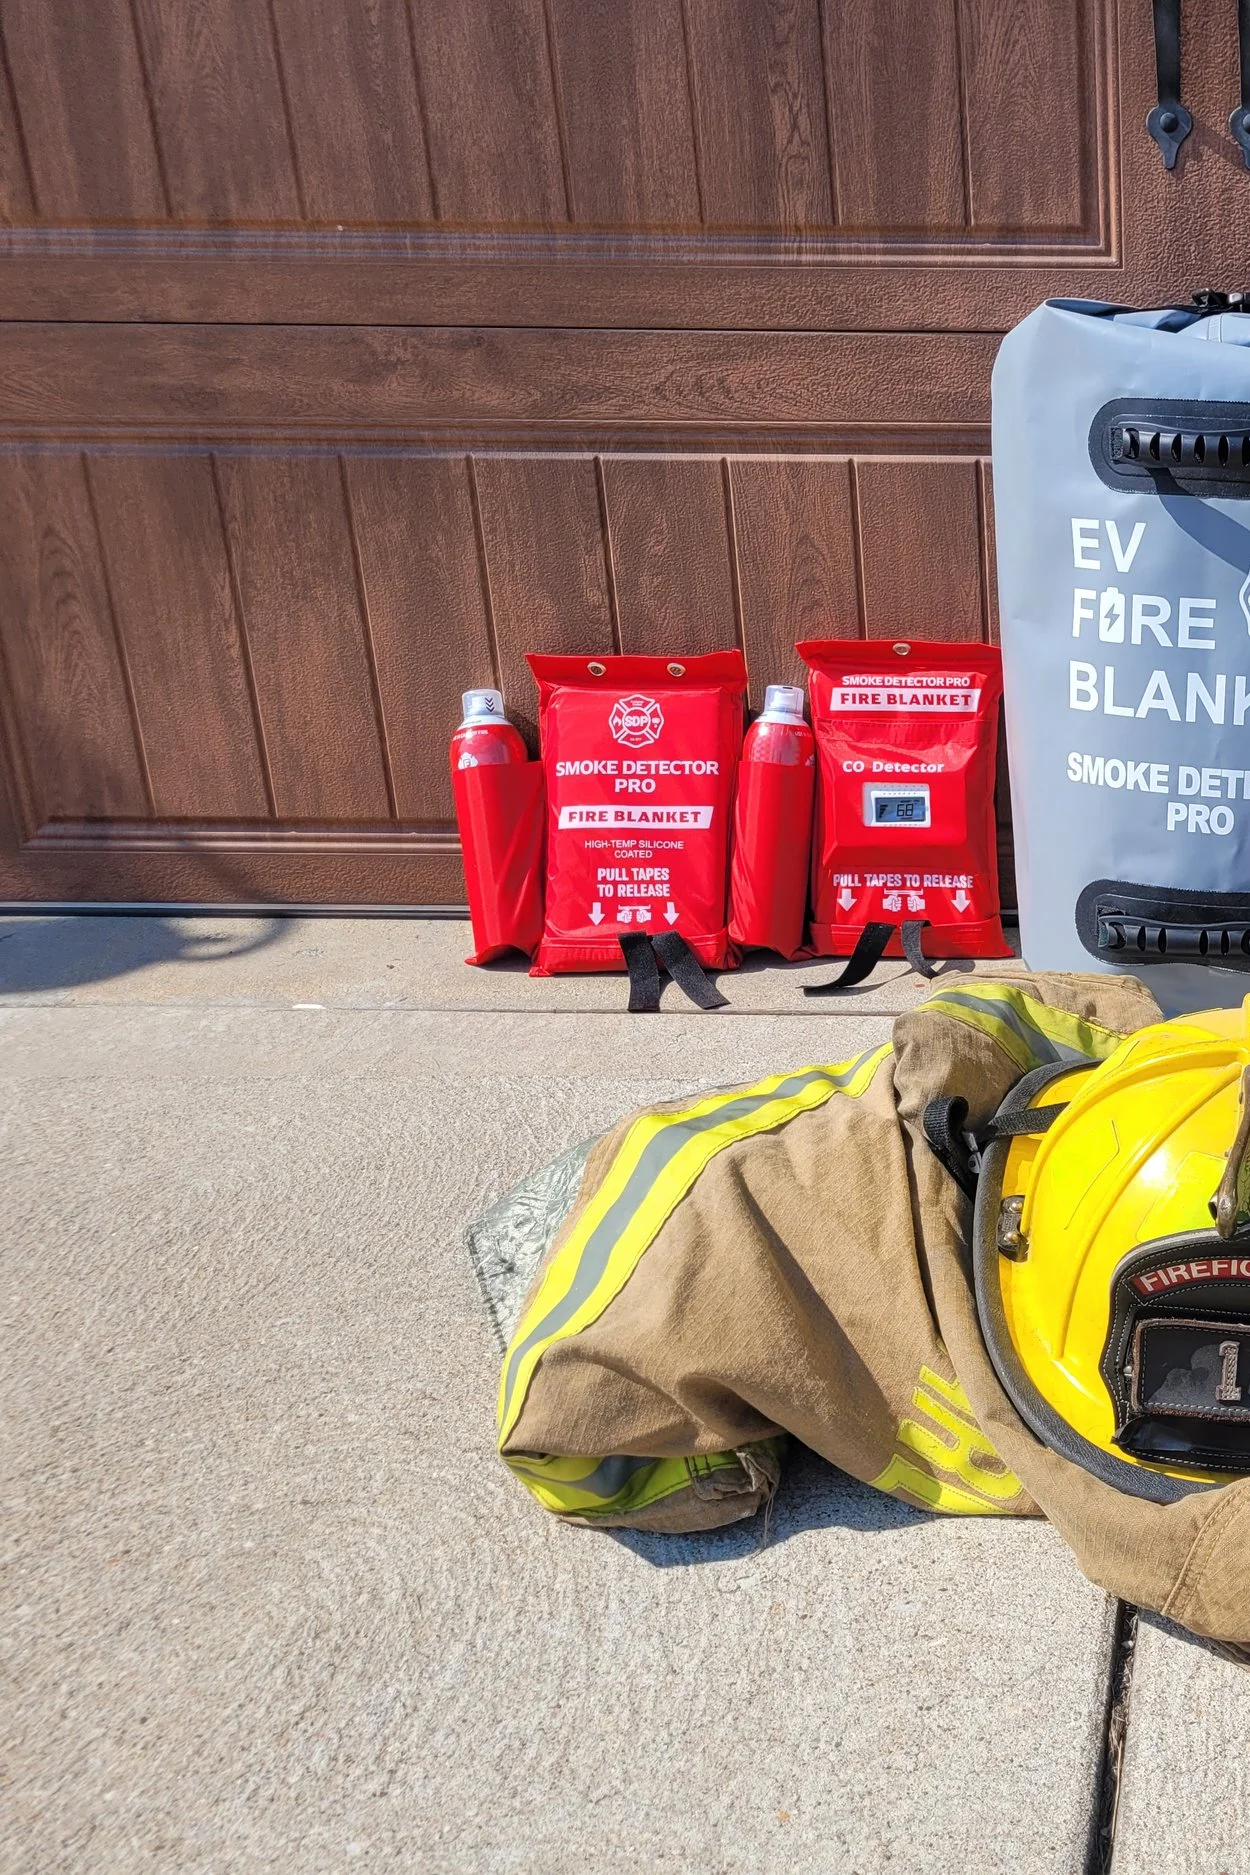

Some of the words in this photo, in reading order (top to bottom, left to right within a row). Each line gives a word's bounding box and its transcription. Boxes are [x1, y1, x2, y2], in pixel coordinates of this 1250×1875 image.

[1071, 517, 1146, 573] EV
[842, 676, 882, 687] SMOKE
[882, 676, 945, 687] DETECTOR
[945, 676, 970, 687] PRO
[840, 692, 882, 705] FIRE
[886, 693, 972, 707] BLANKET
[624, 715, 648, 727] SDP
[555, 760, 619, 777] SMOKE
[622, 760, 719, 776] DETECTOR
[842, 760, 865, 773] CO
[872, 761, 944, 774] Detector
[1066, 751, 1170, 794] SMOKE
[614, 779, 656, 793] PRO
[897, 803, 914, 816] 68
[568, 811, 608, 823] FIRE
[613, 811, 702, 823] BLANKET
[1166, 801, 1235, 836] PRO
[584, 839, 637, 849] HIGH-TEMP
[638, 840, 684, 849] SILICONE
[614, 850, 653, 859] COATED
[597, 868, 629, 881] PULL
[630, 868, 670, 881] TAPES
[833, 874, 862, 887] PULL
[864, 874, 902, 888] TAPES
[904, 874, 921, 888] TO
[923, 874, 974, 889] RELEASE
[597, 884, 615, 898] TO
[617, 884, 670, 898] RELEASE
[1215, 1340, 1241, 1401] 1
